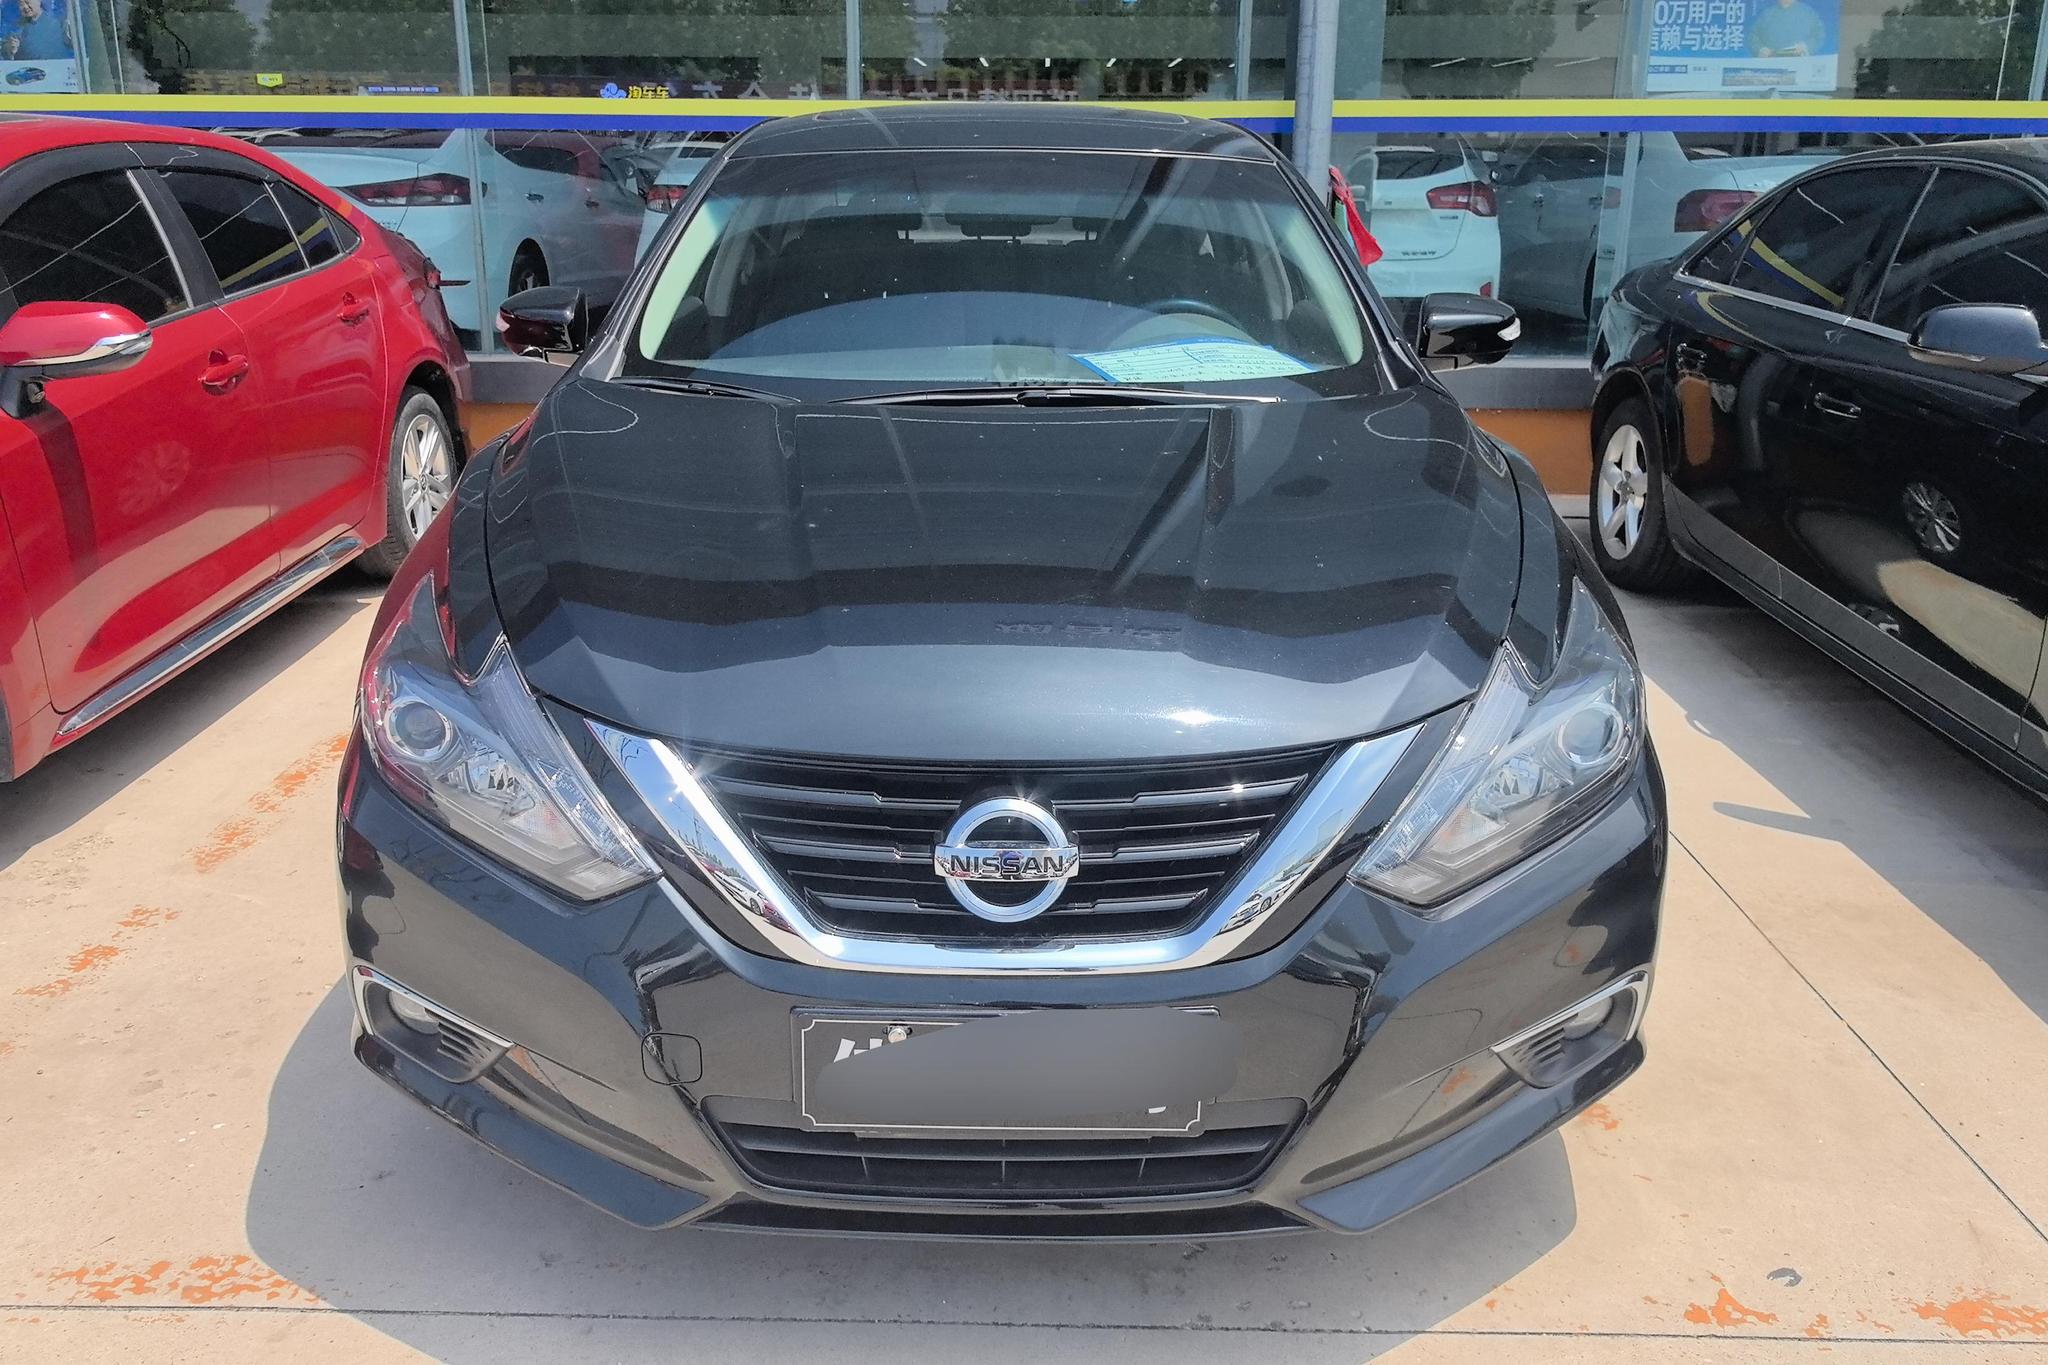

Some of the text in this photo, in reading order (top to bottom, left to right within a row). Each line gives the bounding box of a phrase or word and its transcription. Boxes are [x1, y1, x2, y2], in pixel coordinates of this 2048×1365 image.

[1654, 0, 1745, 25] 0万用户的
[950, 854, 1064, 875] NISSAN
